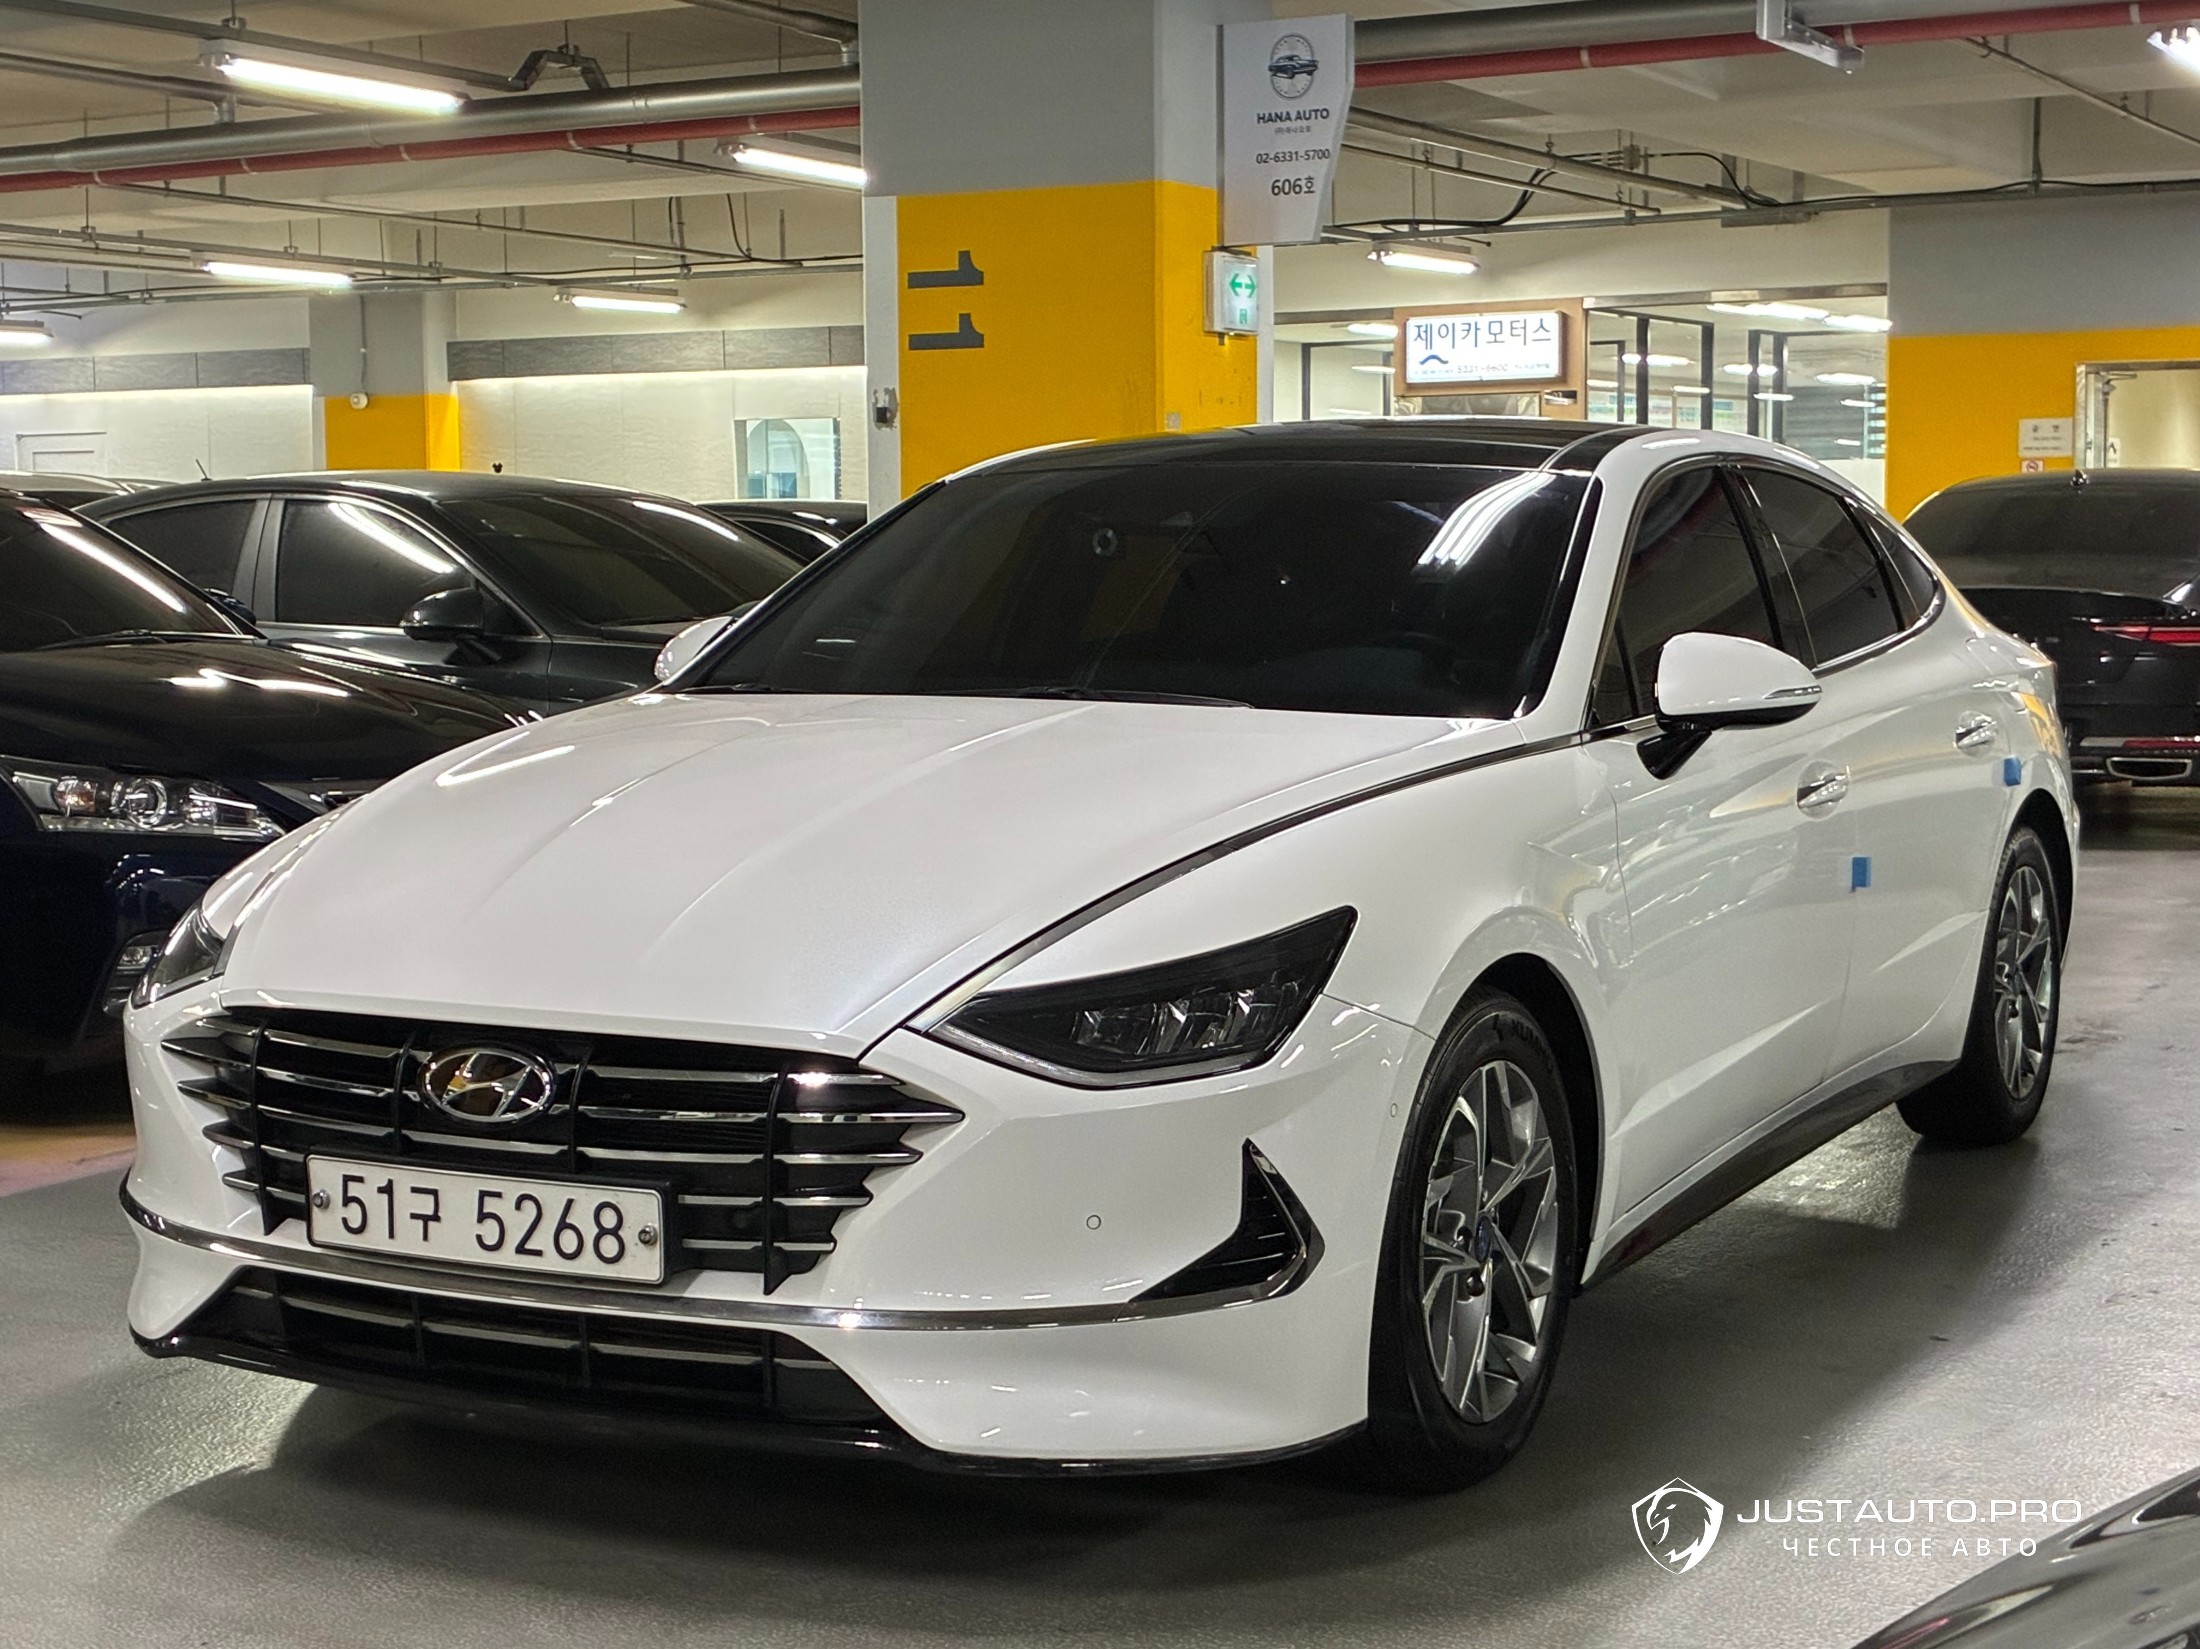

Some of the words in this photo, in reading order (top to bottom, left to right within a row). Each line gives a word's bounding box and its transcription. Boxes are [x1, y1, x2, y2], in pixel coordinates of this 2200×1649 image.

[1256, 110, 1293, 125] HANA
[1294, 107, 1330, 121] AUTO
[1256, 148, 1330, 164] 02-6331-5700
[1271, 175, 1315, 196] 606호
[907, 250, 984, 351] 11
[340, 1173, 442, 1242] 51구
[475, 1189, 626, 1264] 5268
